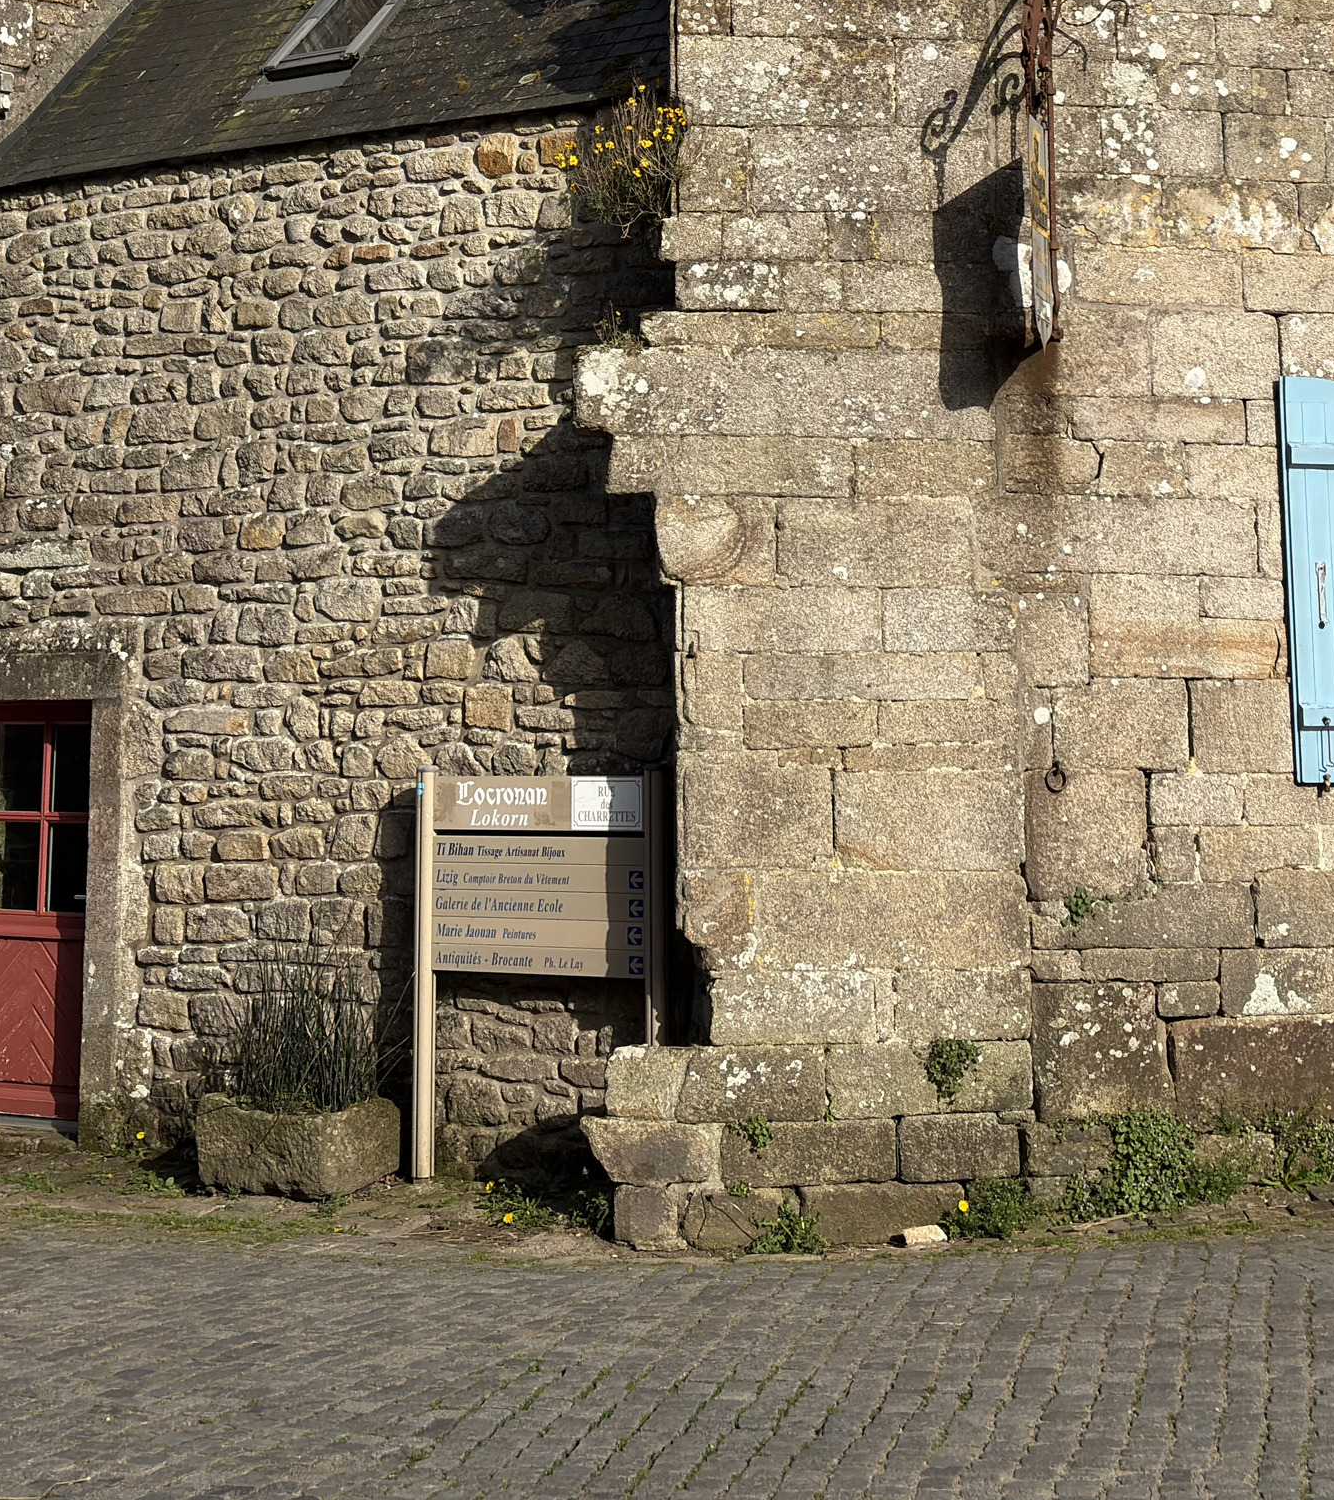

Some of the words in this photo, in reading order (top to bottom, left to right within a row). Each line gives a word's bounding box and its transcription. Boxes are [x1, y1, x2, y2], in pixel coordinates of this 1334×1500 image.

[456, 781, 547, 806] Locronan
[598, 786, 616, 797] RUE
[470, 809, 528, 826] Lokorn
[436, 842, 446, 856] Ti
[448, 843, 474, 856] Bihan
[477, 845, 503, 859] Tissage
[505, 846, 539, 857] Artisanat
[541, 847, 566, 860] Bijoux
[436, 869, 458, 886] Lizig
[463, 872, 496, 886] Comptoir
[498, 873, 522, 884] Breton
[524, 874, 533, 884] du
[536, 873, 570, 885] Vêtement
[435, 896, 468, 910] Galerie
[471, 897, 482, 910] de
[484, 897, 534, 912] l'Ancienne
[436, 923, 463, 937] Marie
[465, 924, 497, 938] Jaouan
[502, 928, 537, 940] Peintures
[435, 951, 482, 967] Antiquités
[491, 952, 534, 967] Brocante
[544, 957, 556, 968] Ph.
[558, 958, 568, 969] Le
[569, 958, 584, 971] Lay
